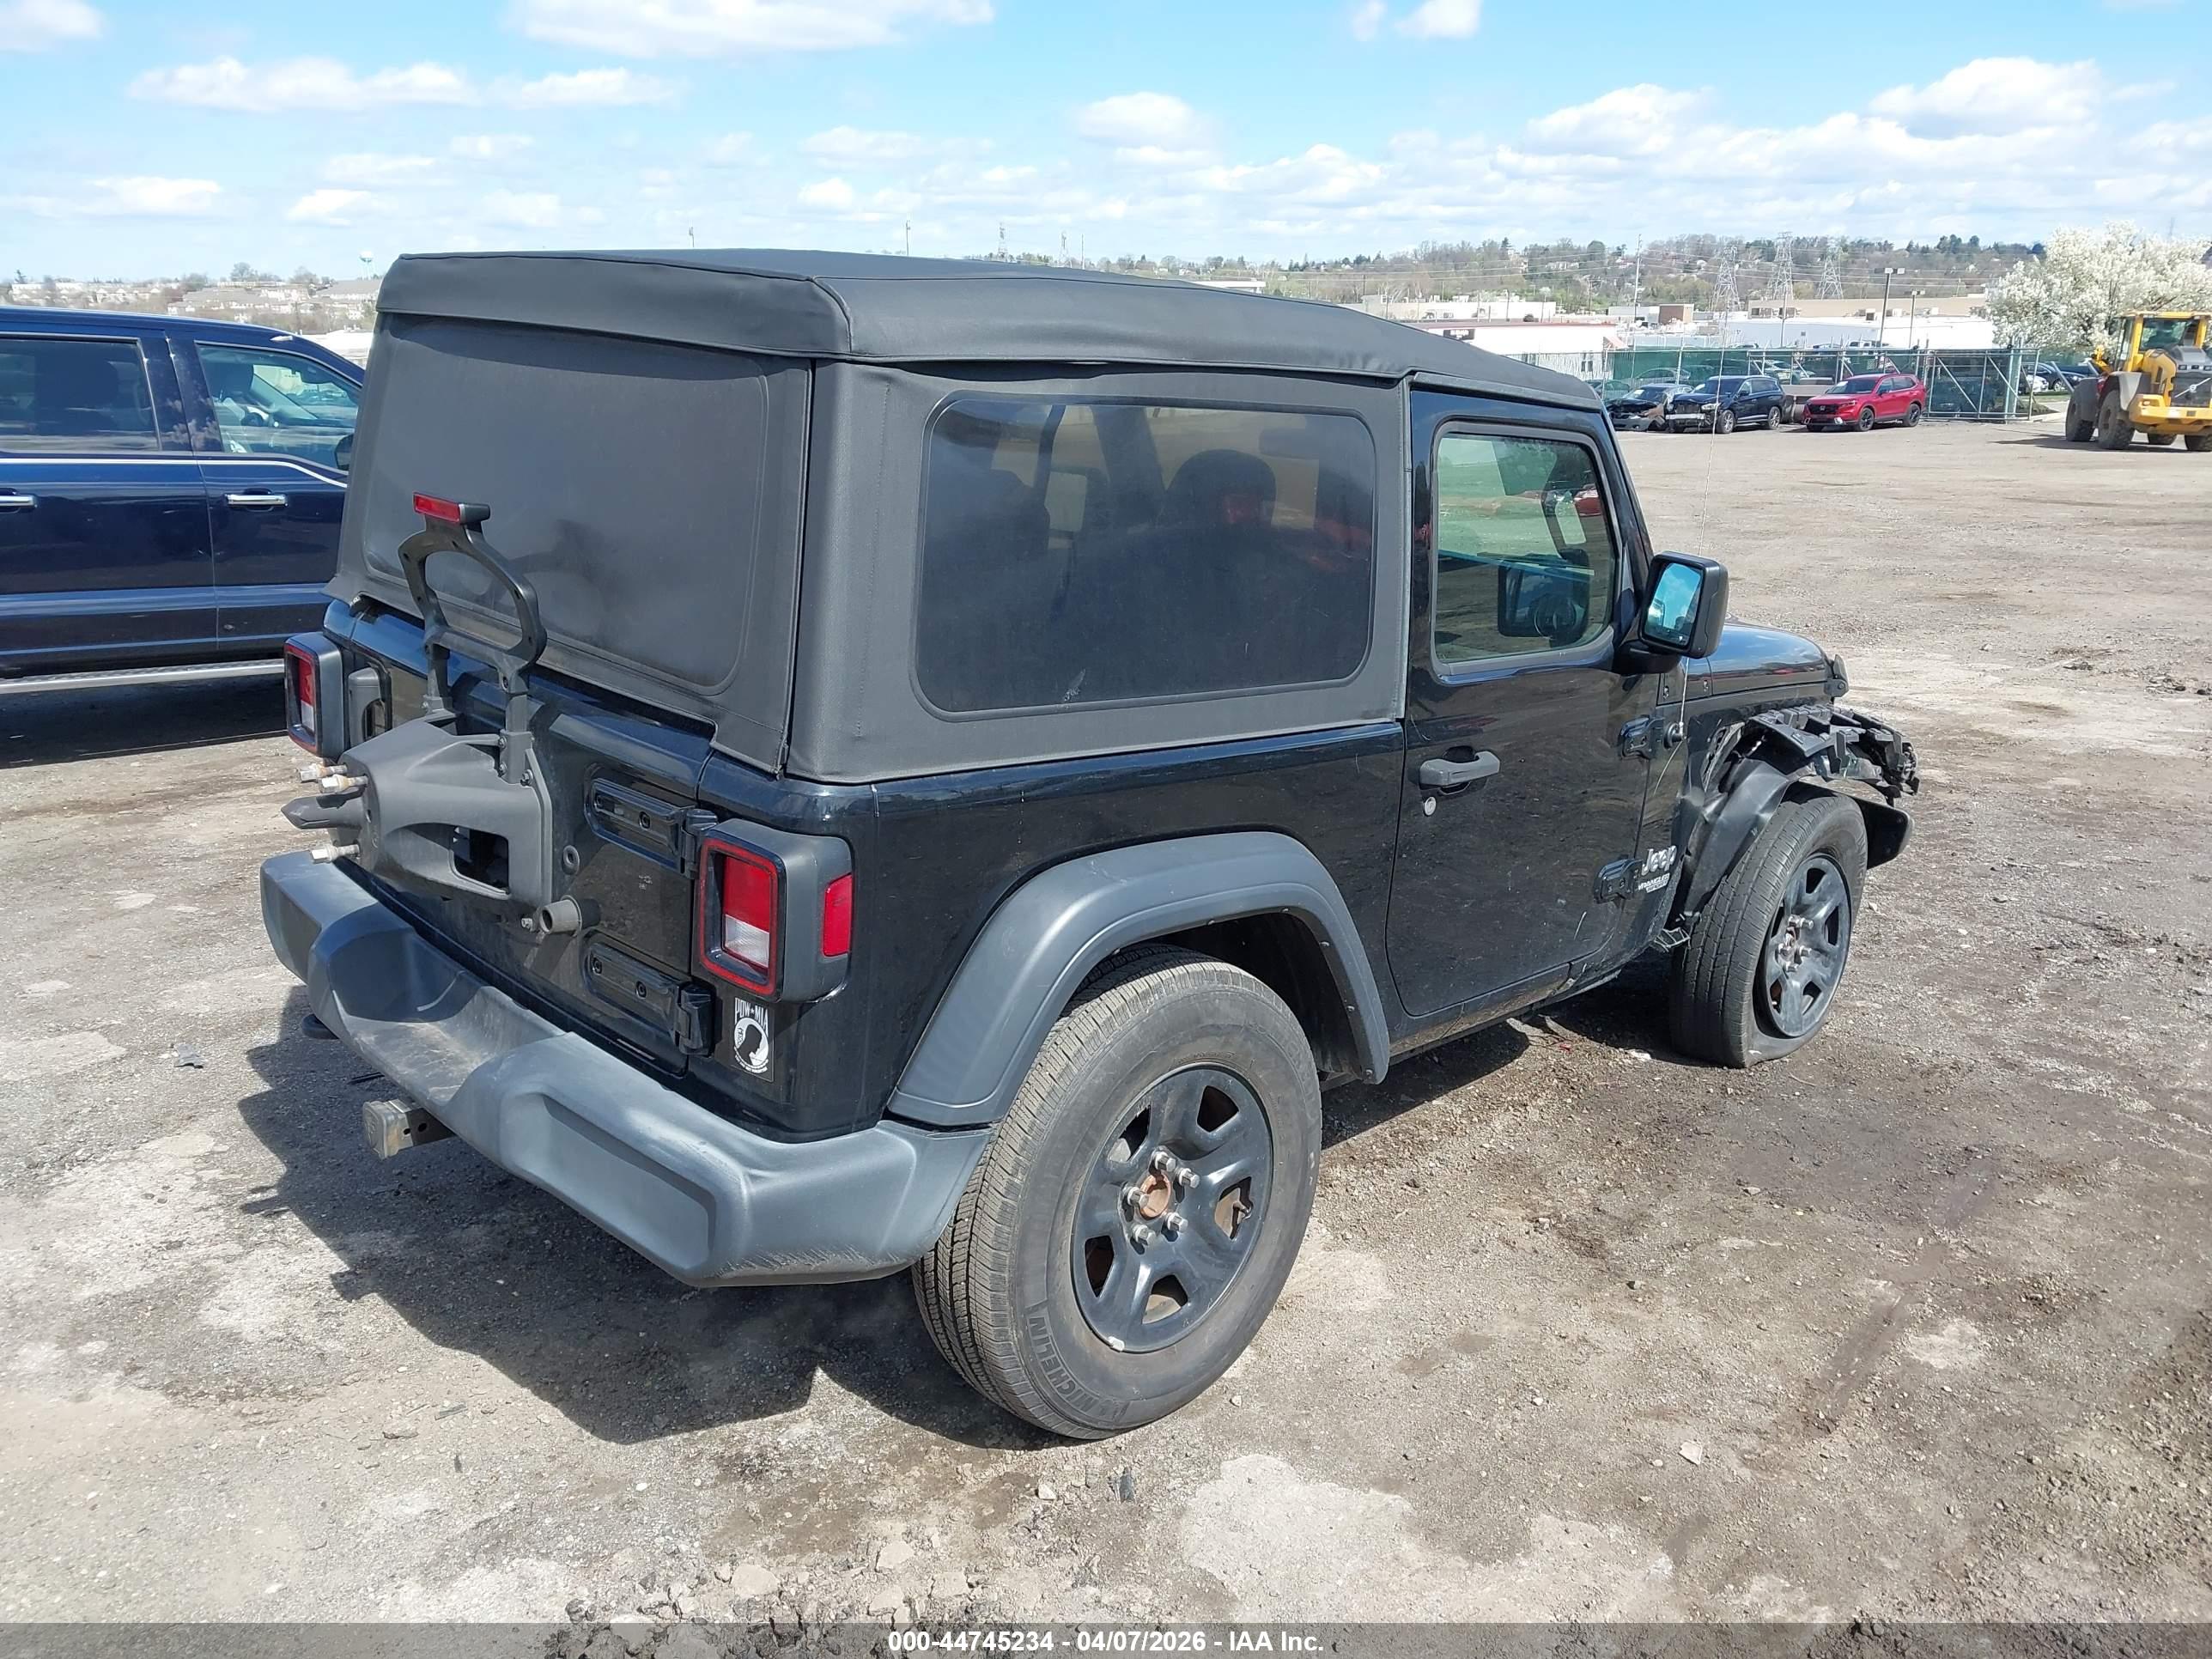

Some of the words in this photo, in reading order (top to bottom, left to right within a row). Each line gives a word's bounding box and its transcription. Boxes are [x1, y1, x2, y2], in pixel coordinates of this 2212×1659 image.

[1641, 846, 1677, 876] Jeep
[735, 997, 751, 1025] POW
[755, 1005, 769, 1038] MIA
[1029, 1316, 1100, 1413] MICHELIN
